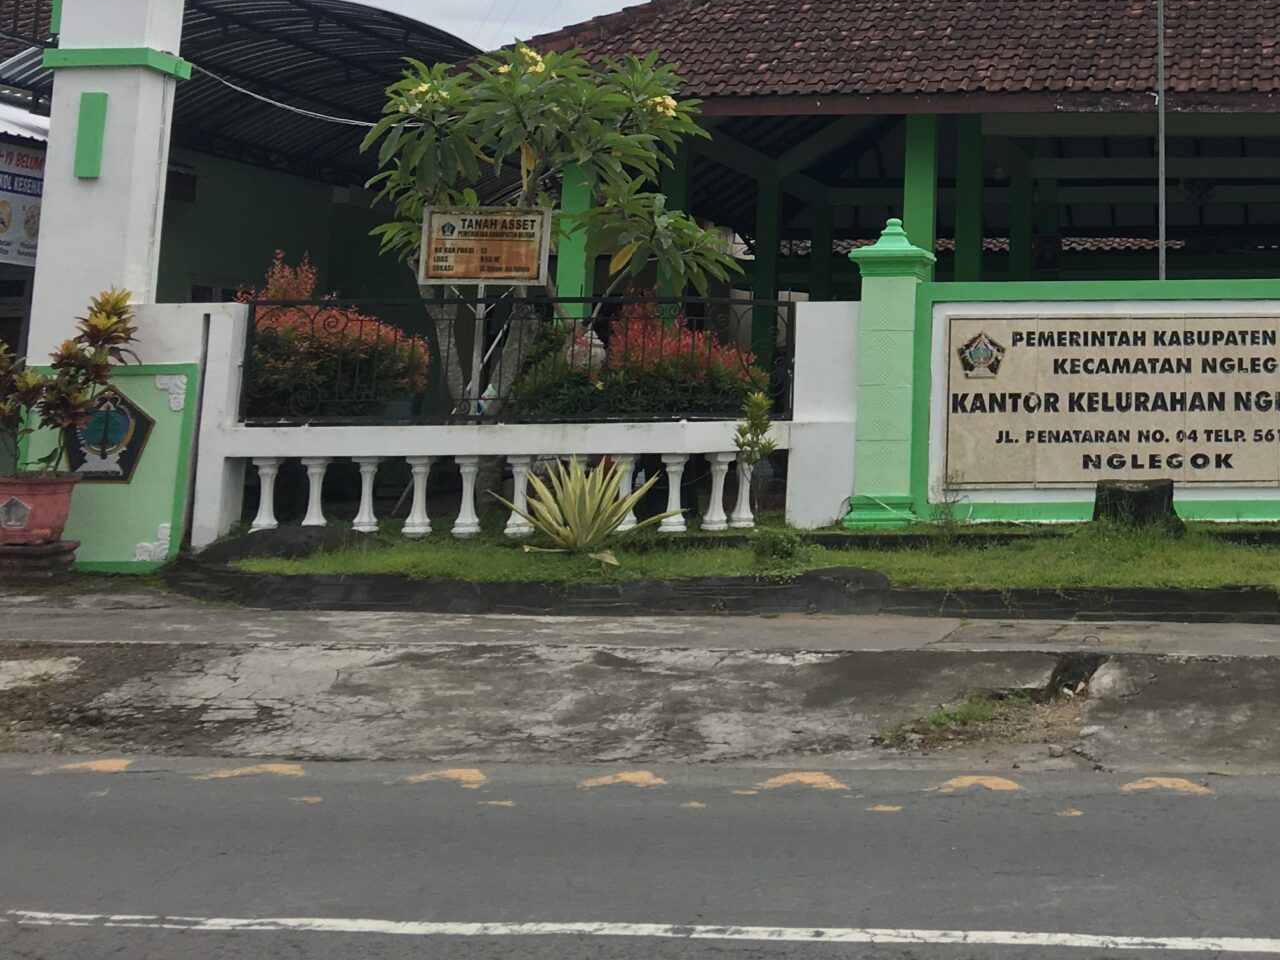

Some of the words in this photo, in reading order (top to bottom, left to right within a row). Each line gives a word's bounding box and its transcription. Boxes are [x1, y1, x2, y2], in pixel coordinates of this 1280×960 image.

[461, 218, 498, 230] TANAH
[501, 219, 537, 231] ASSET
[1011, 330, 1147, 347] PEMERINTAH
[1153, 330, 1277, 346] KABUPATEN
[1053, 357, 1192, 375] KECAMATAN
[951, 392, 1060, 414] KANTOR
[1068, 391, 1226, 413] KELURAHAN
[995, 430, 1019, 444] JL.
[1025, 429, 1131, 444] PENATARAN
[1137, 429, 1170, 444] NO.
[1175, 429, 1199, 443] 04
[1203, 429, 1247, 443] TELP.
[1082, 452, 1234, 470] NGLEGOK
